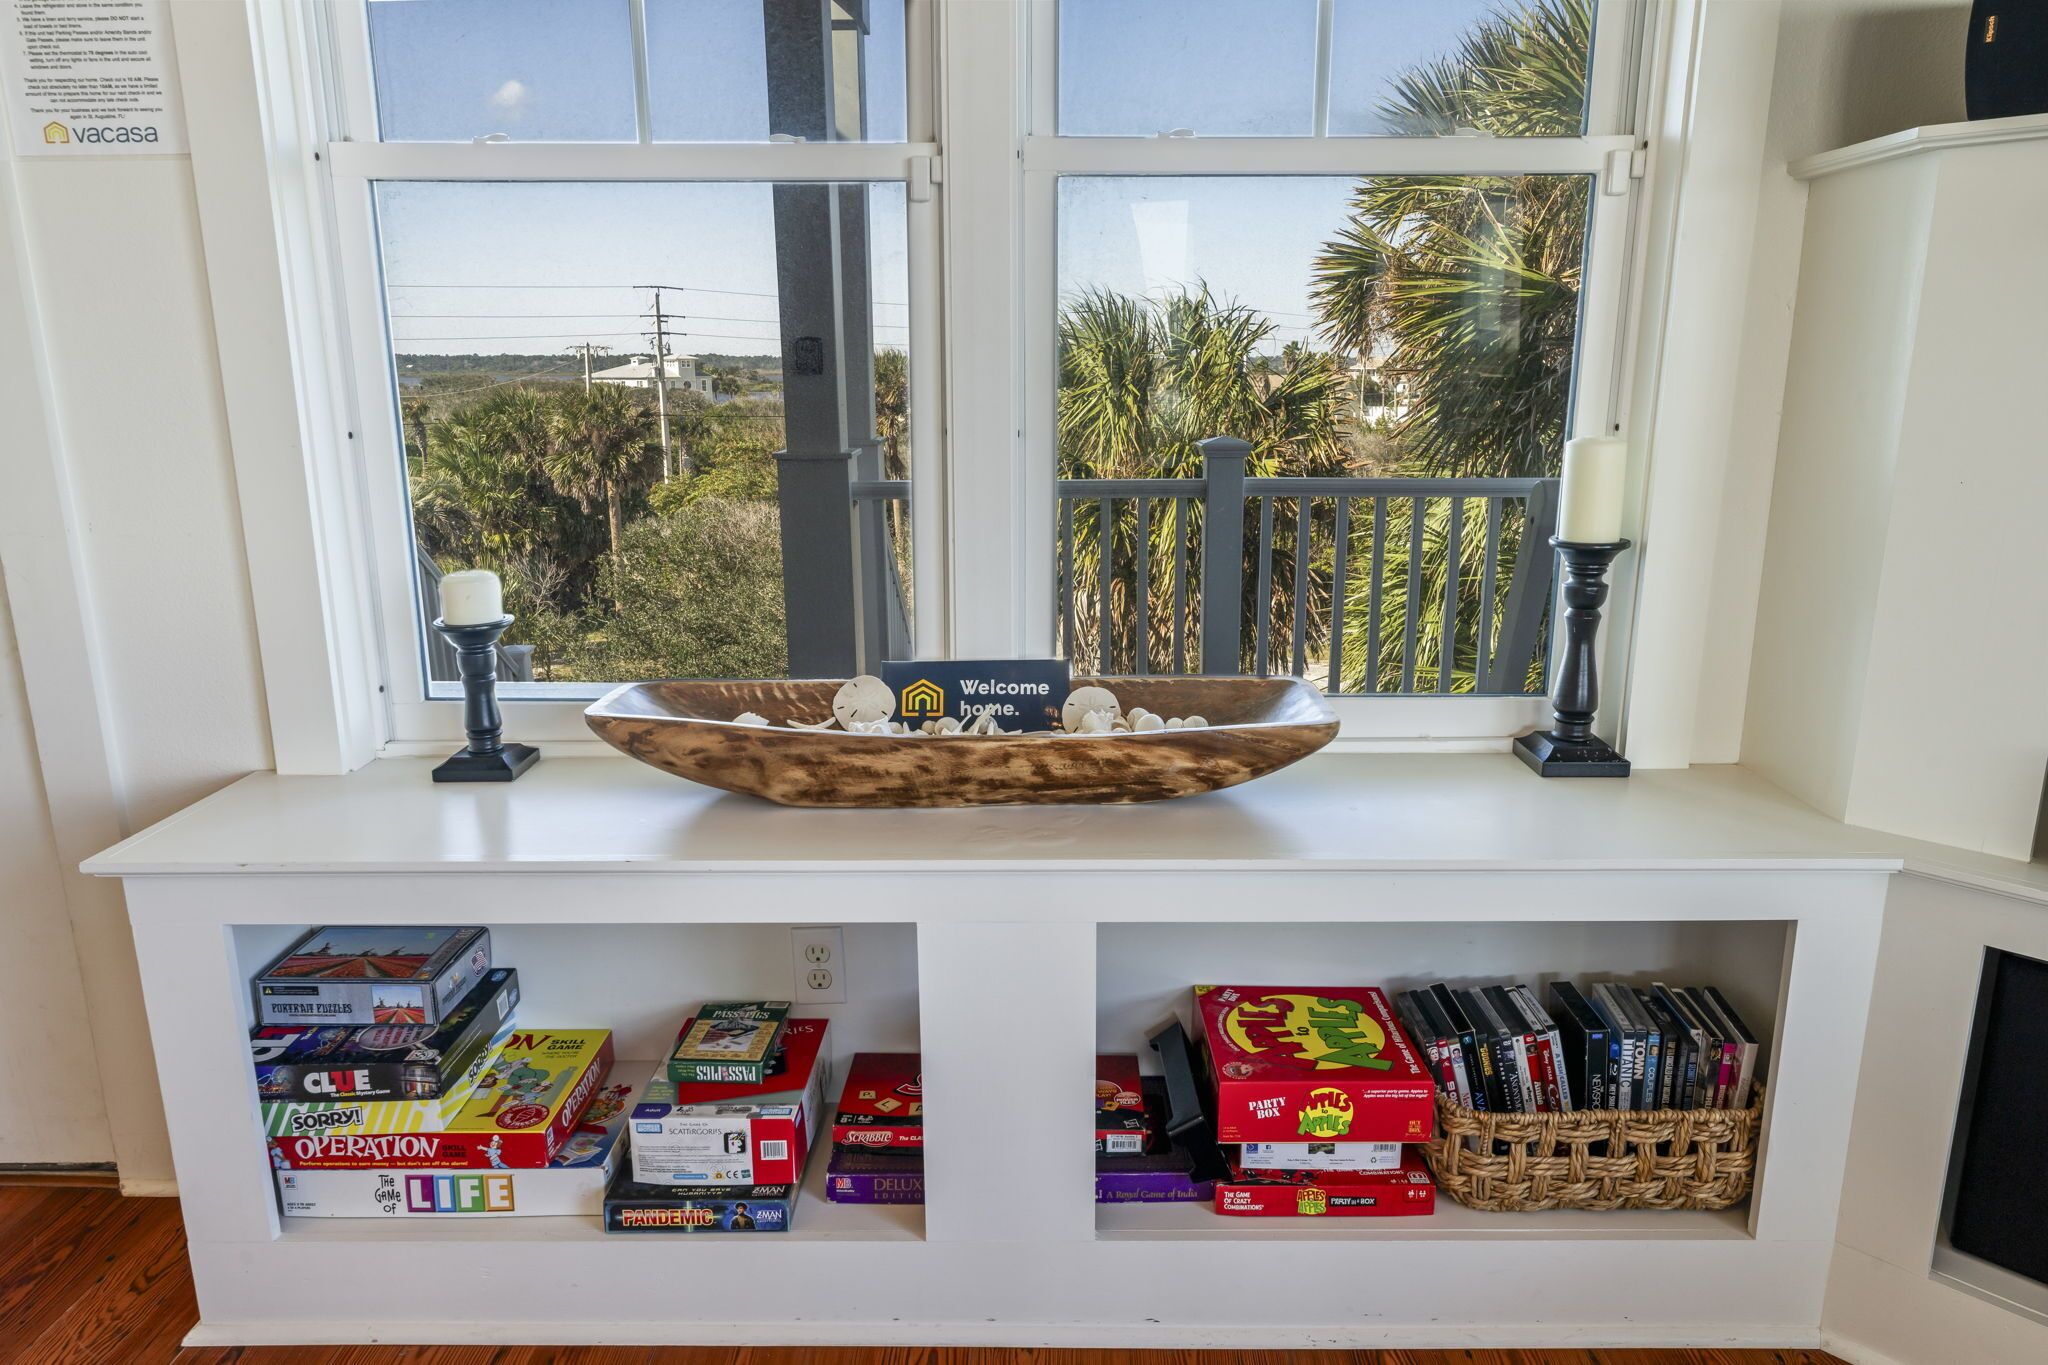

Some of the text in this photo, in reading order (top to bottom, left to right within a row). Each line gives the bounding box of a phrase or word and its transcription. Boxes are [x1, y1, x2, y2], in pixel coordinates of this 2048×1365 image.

[72, 126, 158, 144] vacasa
[960, 679, 1050, 695] Welcome
[272, 1003, 353, 1014] PORTRAIT PUZZLES
[712, 1009, 770, 1019] PASS PIGS
[1237, 998, 1318, 1072] APPLES
[1296, 1026, 1310, 1036] to
[1307, 997, 1394, 1072] APPLES
[1401, 1048, 1414, 1064] Game
[1480, 1047, 1493, 1076] GOONIES
[1620, 1040, 1634, 1088] TITANIC
[1634, 1039, 1646, 1080] TOWN
[696, 1066, 722, 1081] PIGS
[729, 1066, 756, 1082] PASS
[1410, 1063, 1420, 1074] The
[304, 1069, 372, 1094] CLUE
[1646, 1066, 1655, 1103] COUPLES
[562, 1057, 601, 1127] OPERATION
[1534, 1082, 1544, 1106] Annie
[1592, 1074, 1601, 1110] NEWSRO
[1249, 1097, 1286, 1111] PARTY
[1300, 1090, 1351, 1112] APPLES
[291, 1106, 362, 1131] SORRY!
[1256, 1107, 1280, 1120] BOX
[1297, 1112, 1351, 1136] APPLES
[844, 1131, 893, 1144] SCRABBLE
[294, 1136, 440, 1160] OPERATION
[874, 1178, 924, 1190] DELUX
[408, 1177, 512, 1210] LIFE
[1116, 1188, 1139, 1199] Royal
[1141, 1190, 1166, 1198] Game
[1168, 1188, 1176, 1199] of
[1178, 1188, 1198, 1198] India
[1297, 1189, 1326, 1202] APPLES
[1298, 1201, 1326, 1214] APPLES
[622, 1209, 714, 1226] PANDEMIC
